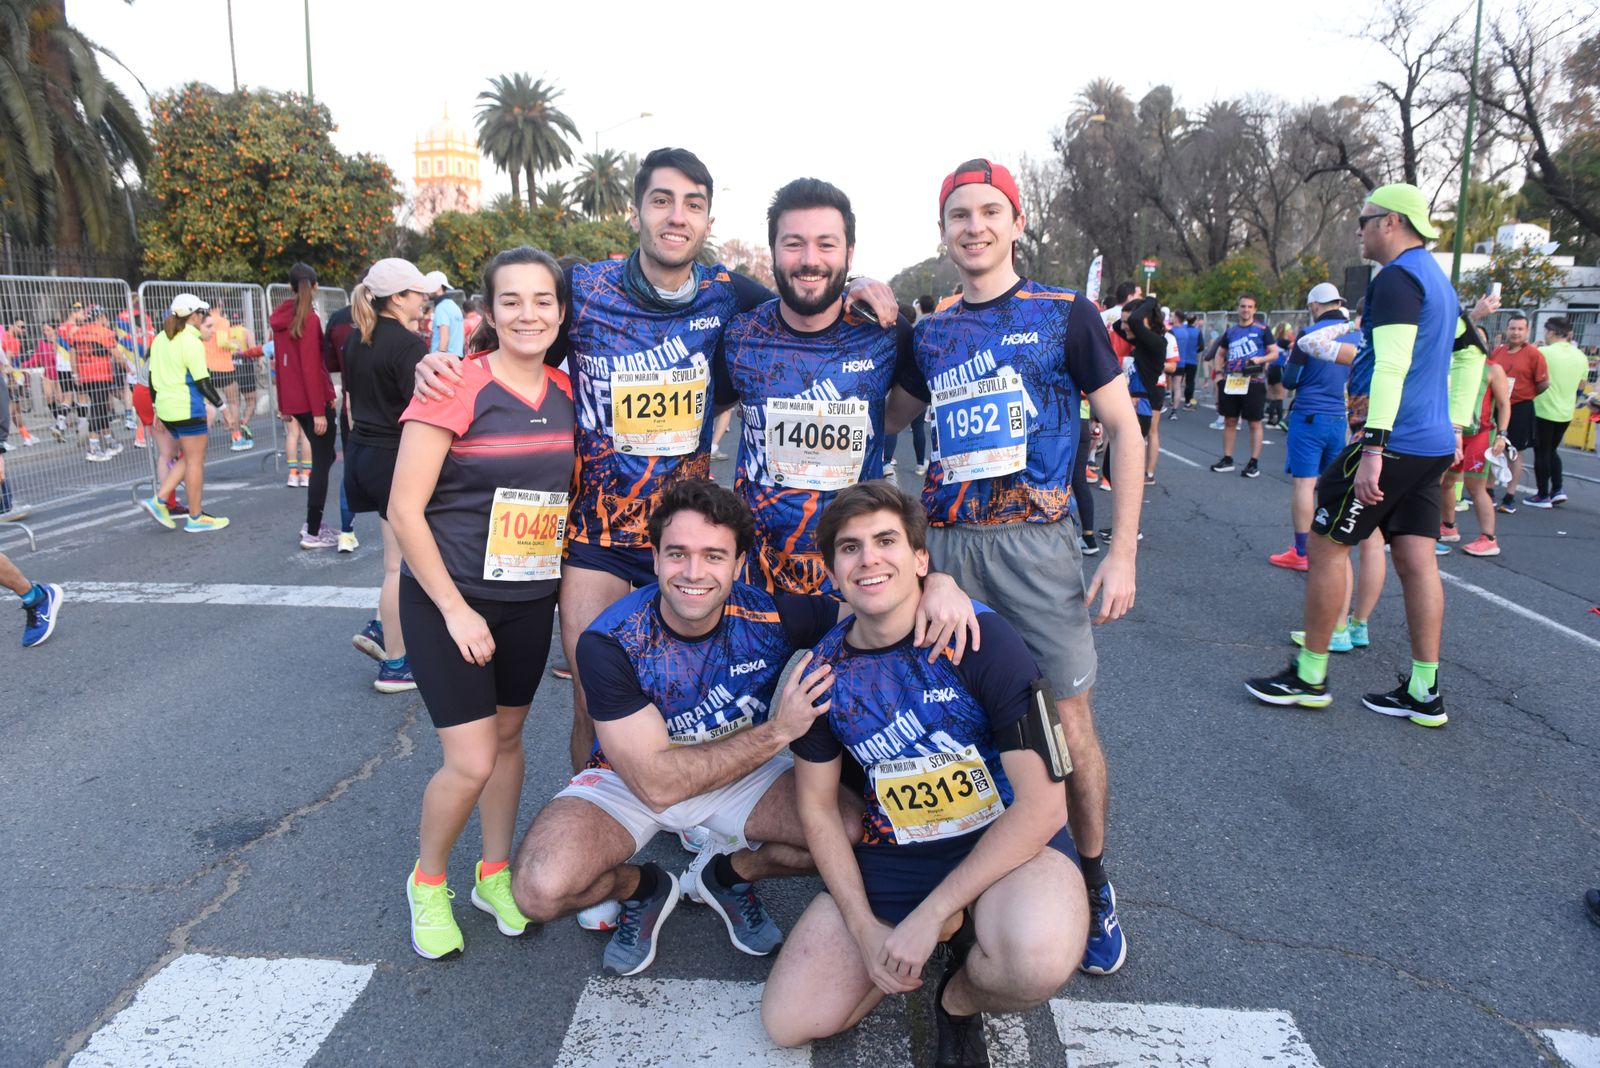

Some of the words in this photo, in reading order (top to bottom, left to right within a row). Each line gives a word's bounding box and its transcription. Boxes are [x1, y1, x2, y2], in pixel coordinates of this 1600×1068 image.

[690, 316, 721, 331] HOKA
[1001, 332, 1039, 346] HOKA
[613, 335, 690, 373] MARATÓN
[617, 373, 634, 382] MEDIO
[634, 372, 659, 382] MARATÓN
[672, 368, 697, 383] SEVILLA
[842, 359, 875, 373] HOKA
[934, 349, 997, 391] MARATÓN
[977, 377, 1008, 394] SEVILLA
[621, 390, 692, 419] 12311
[772, 401, 788, 410] MEDIO
[789, 402, 815, 411] MARATÓN
[828, 403, 856, 415] SEVILLA
[946, 403, 1000, 439] 1952
[774, 421, 850, 450] 14068
[500, 511, 558, 539] 10428
[730, 659, 767, 677] HOKA
[923, 687, 959, 704] HOKA
[665, 683, 735, 732] MARATÓN
[710, 721, 739, 739] SEVILLA
[853, 709, 927, 764] MARATÓN
[886, 769, 974, 812] 12313
